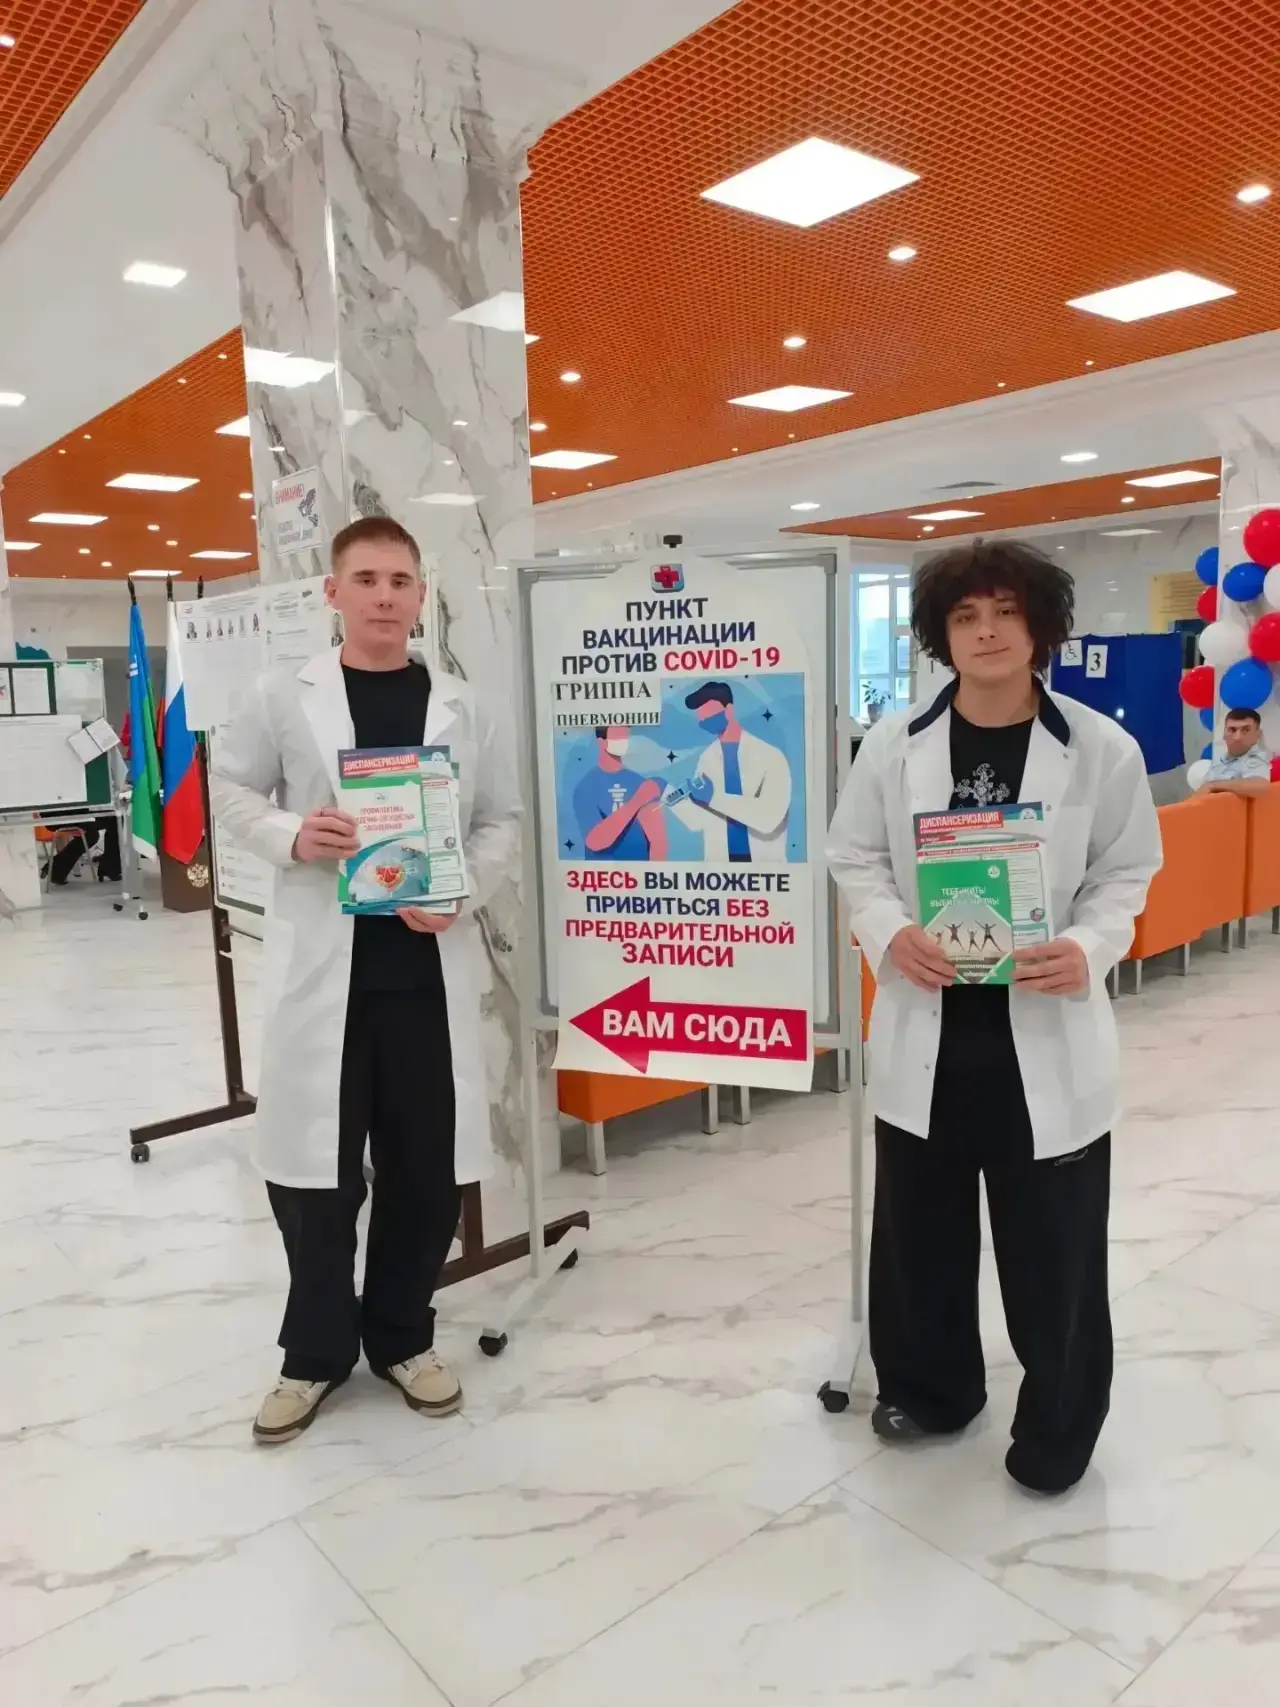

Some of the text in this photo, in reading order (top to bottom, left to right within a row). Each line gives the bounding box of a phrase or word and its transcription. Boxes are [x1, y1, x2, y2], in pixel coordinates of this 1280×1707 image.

[626, 597, 708, 622] ПУНКТ
[582, 621, 756, 651] ВАКЦИНАЦИИ
[561, 646, 780, 675] ПРОТИВ COVID-19
[1089, 652, 1101, 672] 3
[555, 681, 652, 701] ГРИППА
[556, 712, 660, 727] ПНЕВМОНИИ
[343, 753, 415, 771] ДИСПАНСЕРИЗАЦИЯ
[920, 811, 999, 829] ДИСПАНСЕРИЗАЦИЯ
[566, 870, 790, 892] ЗДЕСЬ ВЫ МОЖЕТЕ
[586, 895, 769, 918] ПРИВИТЬСЯ БЕЗ
[565, 919, 795, 945] ПРЕДВАРИТЕЛЬНОЙ
[621, 942, 734, 968] ЗАПИСИ
[602, 1008, 792, 1052] ВАМ СЮДА
